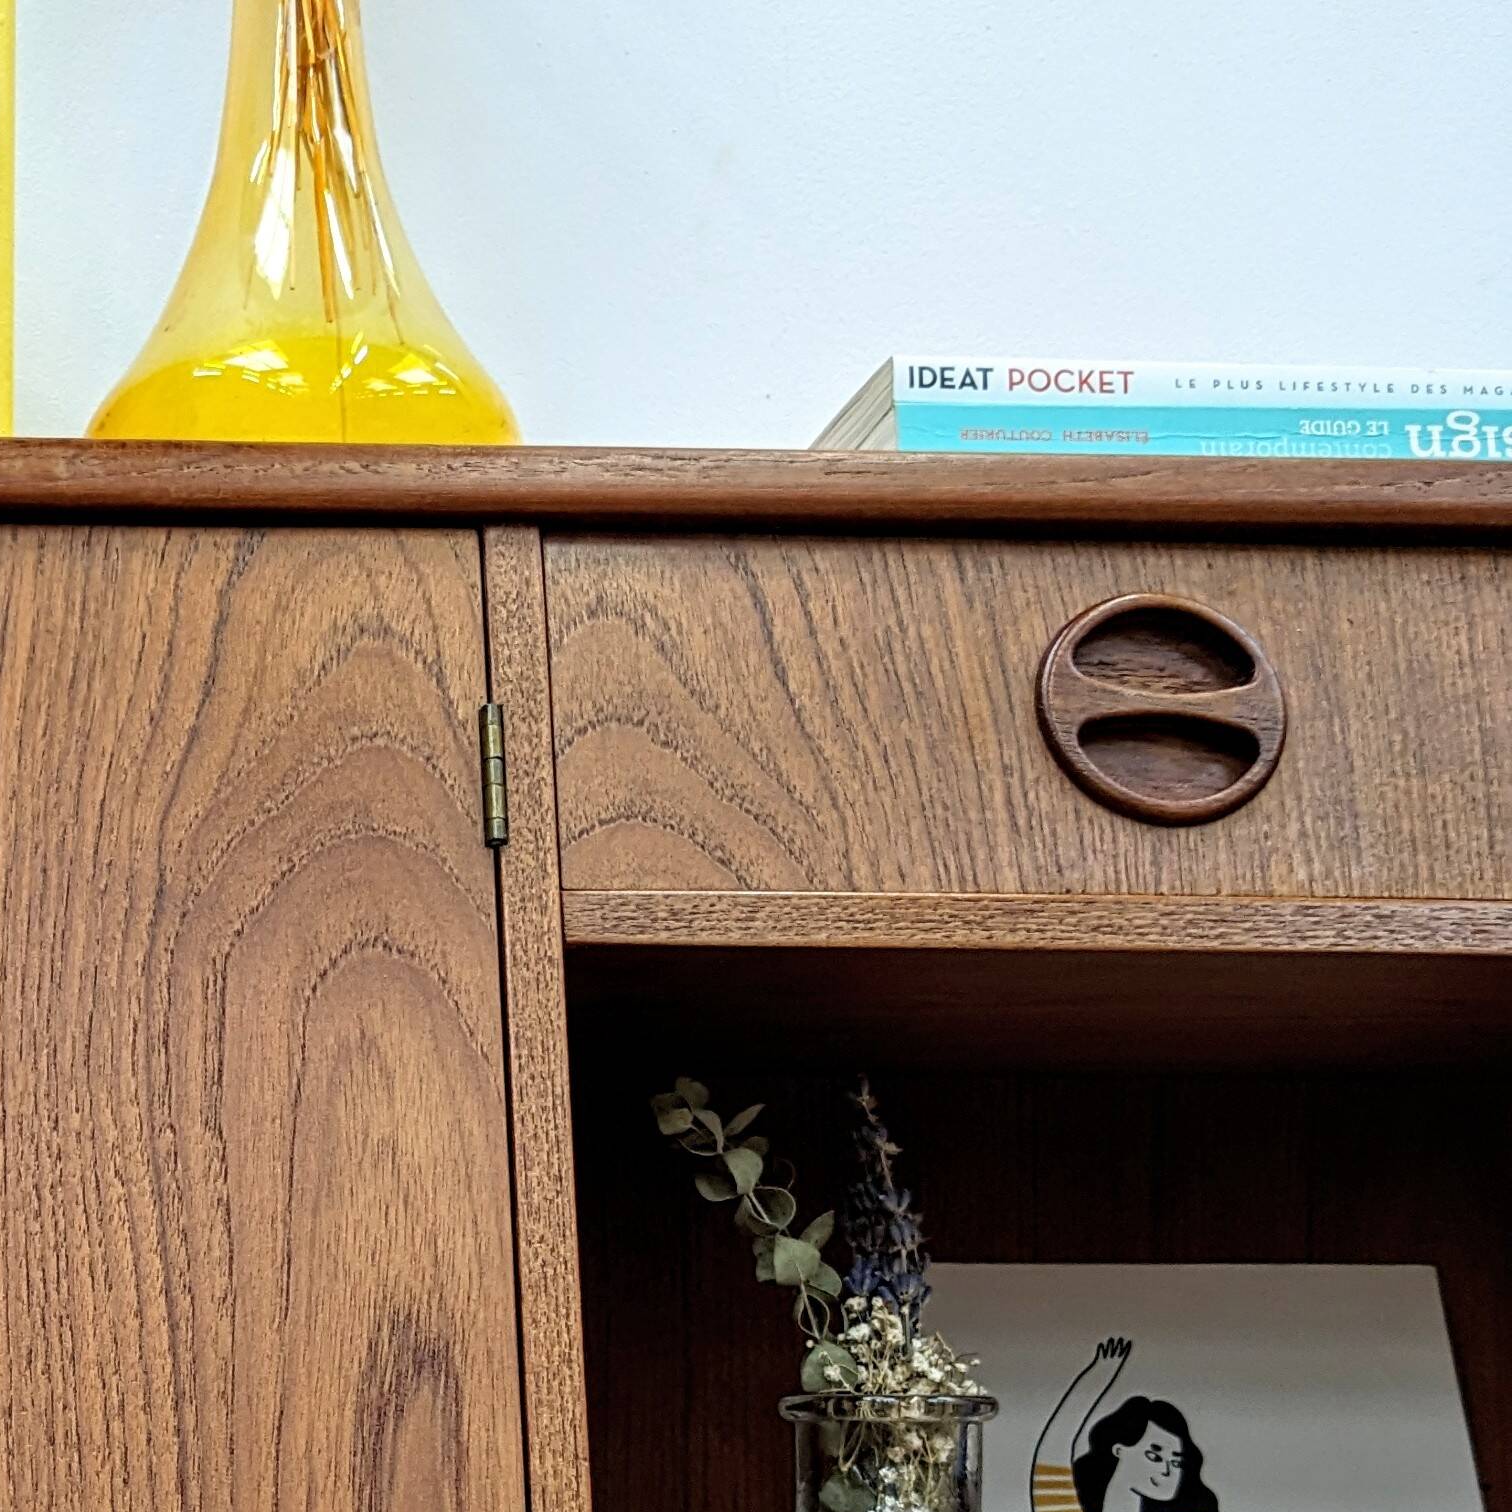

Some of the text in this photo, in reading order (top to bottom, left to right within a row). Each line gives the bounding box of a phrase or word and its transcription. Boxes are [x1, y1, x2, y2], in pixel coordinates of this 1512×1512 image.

[909, 366, 1512, 396] IDEAT POCKET LE PLUS LIFESTYLE DES MAG
[960, 429, 1052, 442] COUTURIER
[1299, 419, 1389, 436] LE GUIDE
[1199, 437, 1393, 459] contemporain
